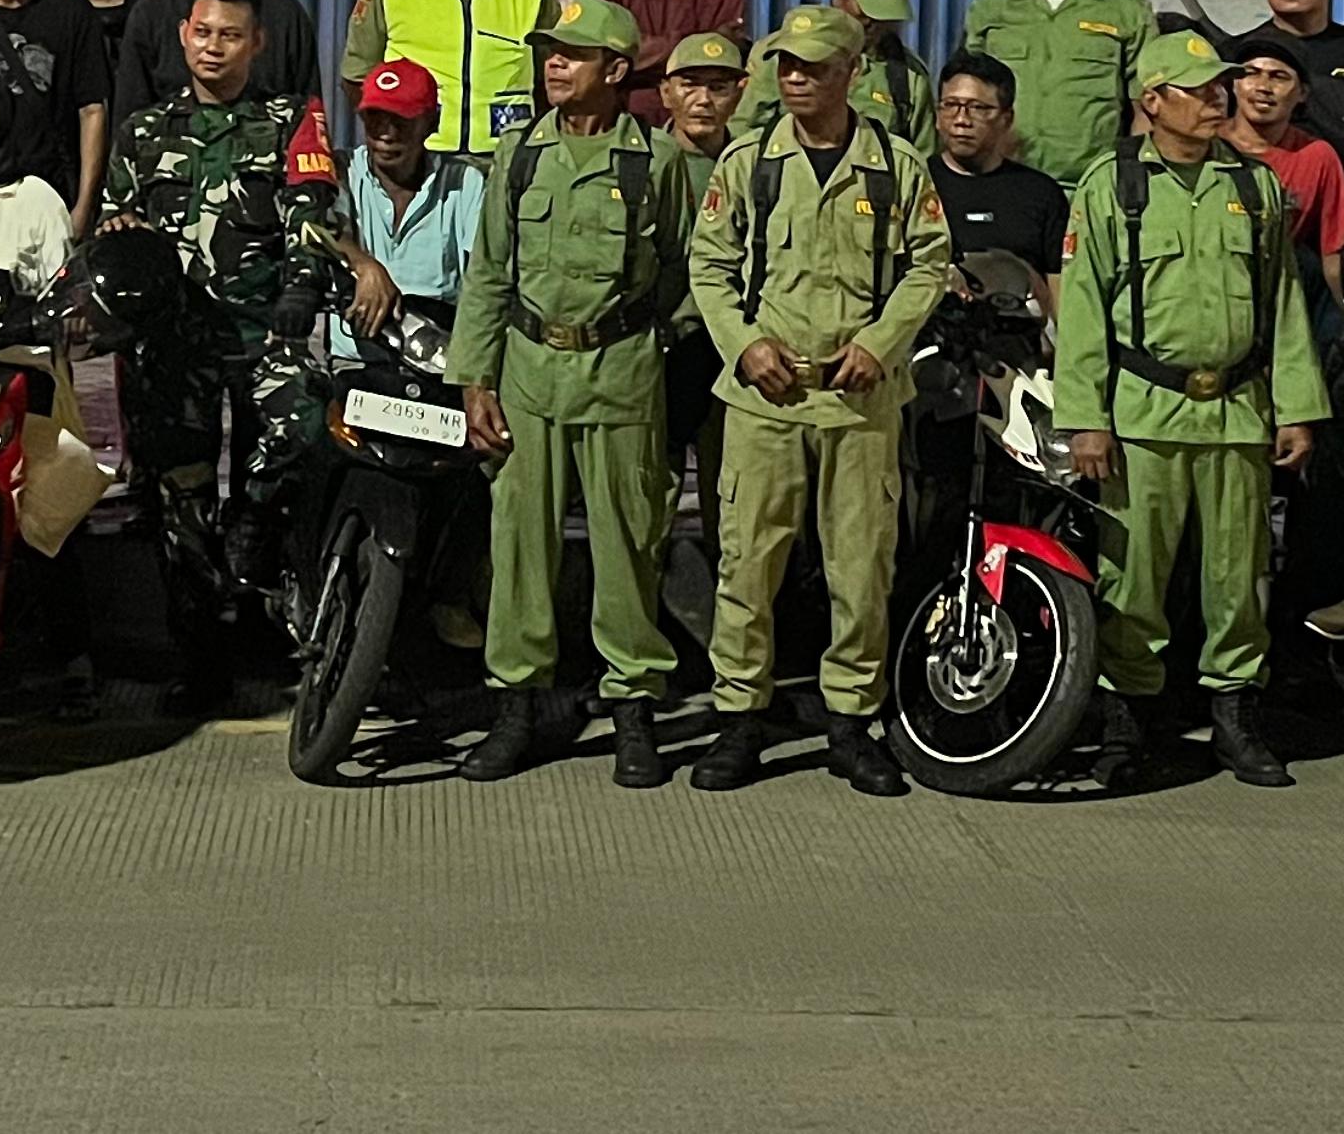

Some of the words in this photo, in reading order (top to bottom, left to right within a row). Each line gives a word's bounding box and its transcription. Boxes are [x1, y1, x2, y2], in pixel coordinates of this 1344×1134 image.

[353, 394, 364, 408] H
[381, 400, 426, 420] 2969
[439, 412, 462, 429] NR
